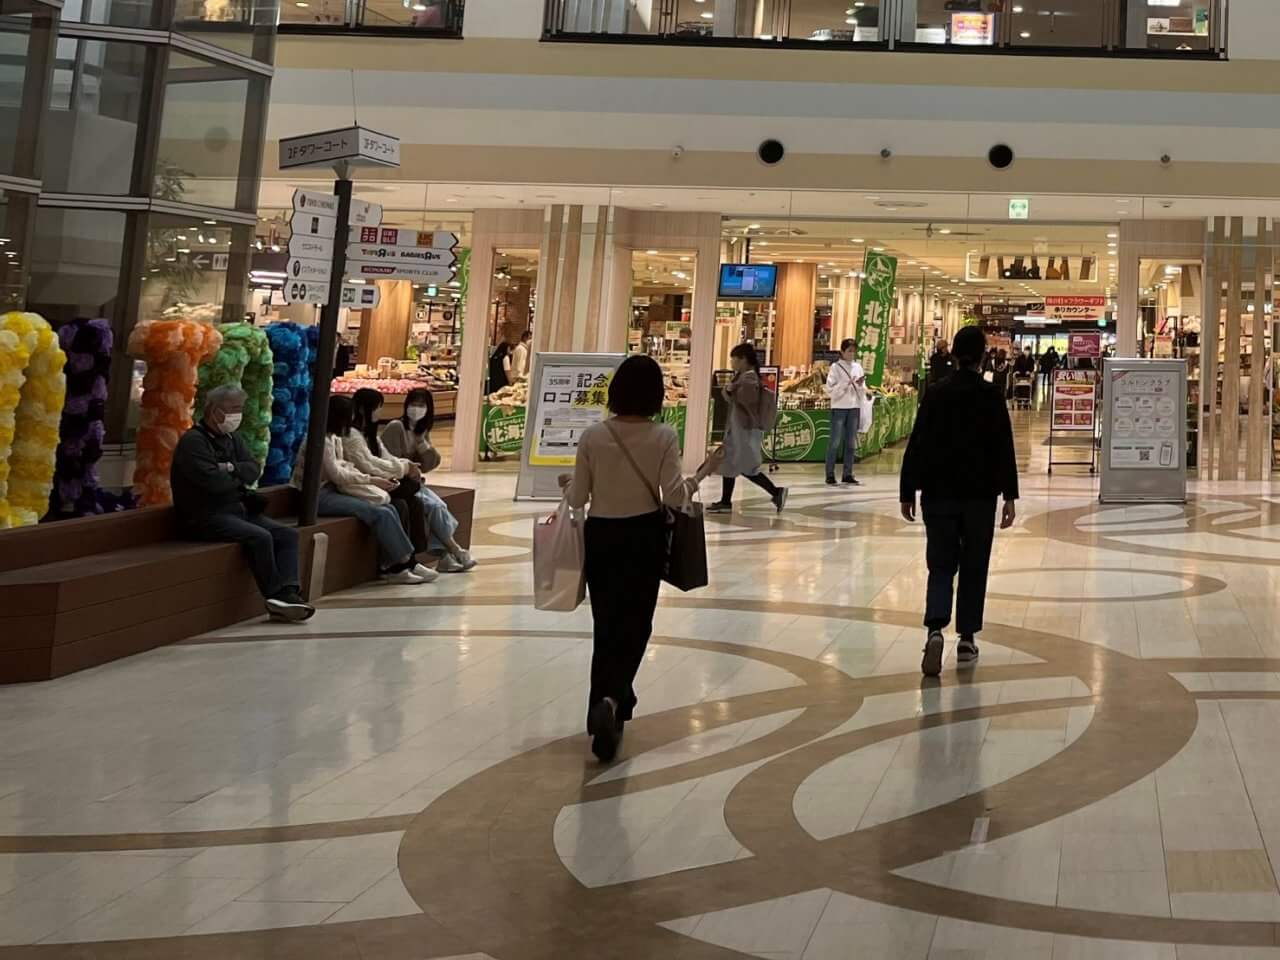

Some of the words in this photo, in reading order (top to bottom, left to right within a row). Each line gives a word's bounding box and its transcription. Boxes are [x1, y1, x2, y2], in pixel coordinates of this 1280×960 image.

[861, 300, 884, 375] 北海道
[576, 373, 610, 388] 記念
[543, 390, 607, 406] ロゴ募集
